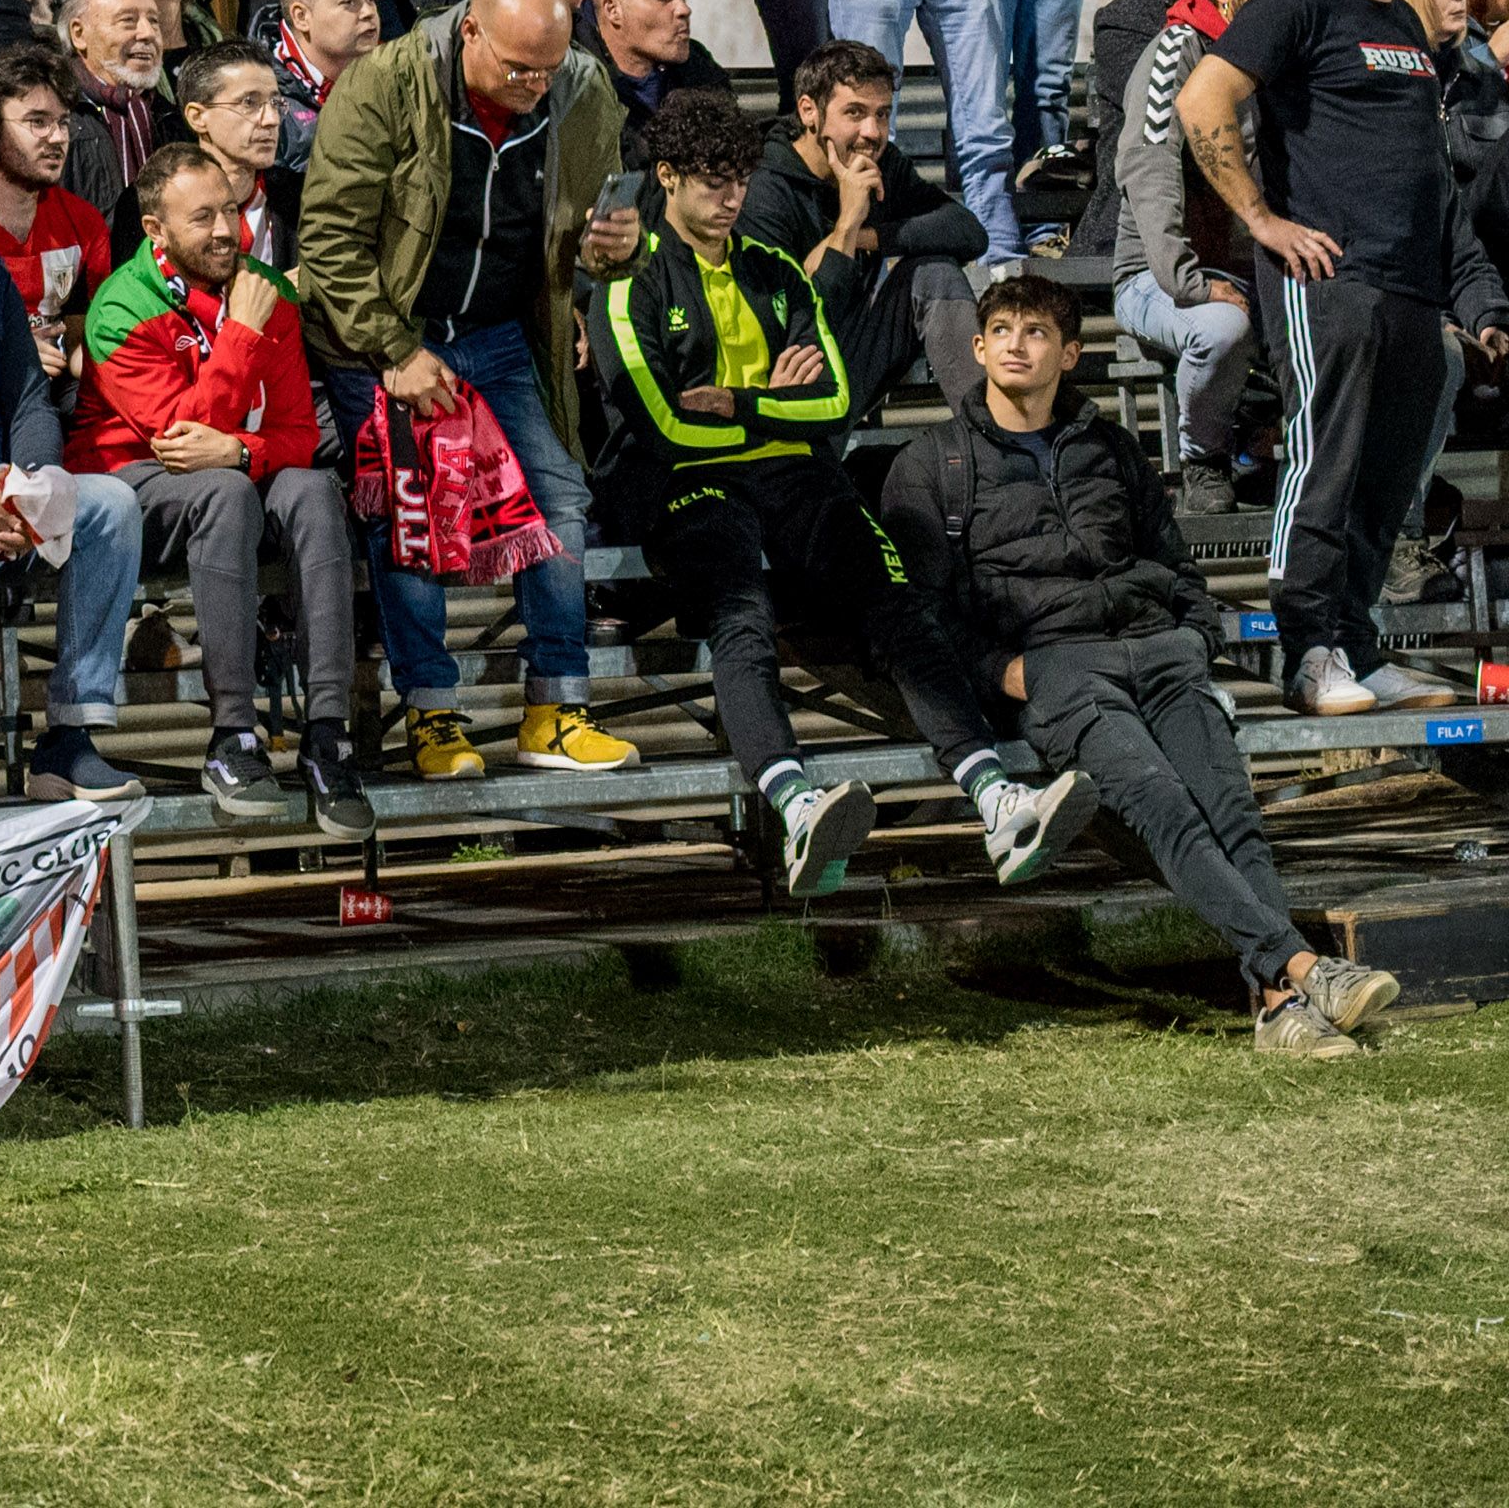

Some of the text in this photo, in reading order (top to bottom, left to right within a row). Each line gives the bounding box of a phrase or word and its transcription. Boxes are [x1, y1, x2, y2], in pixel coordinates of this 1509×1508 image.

[668, 486, 726, 512] KELME
[1251, 621, 1277, 632] FILA
[1437, 726, 1464, 738] FILA
